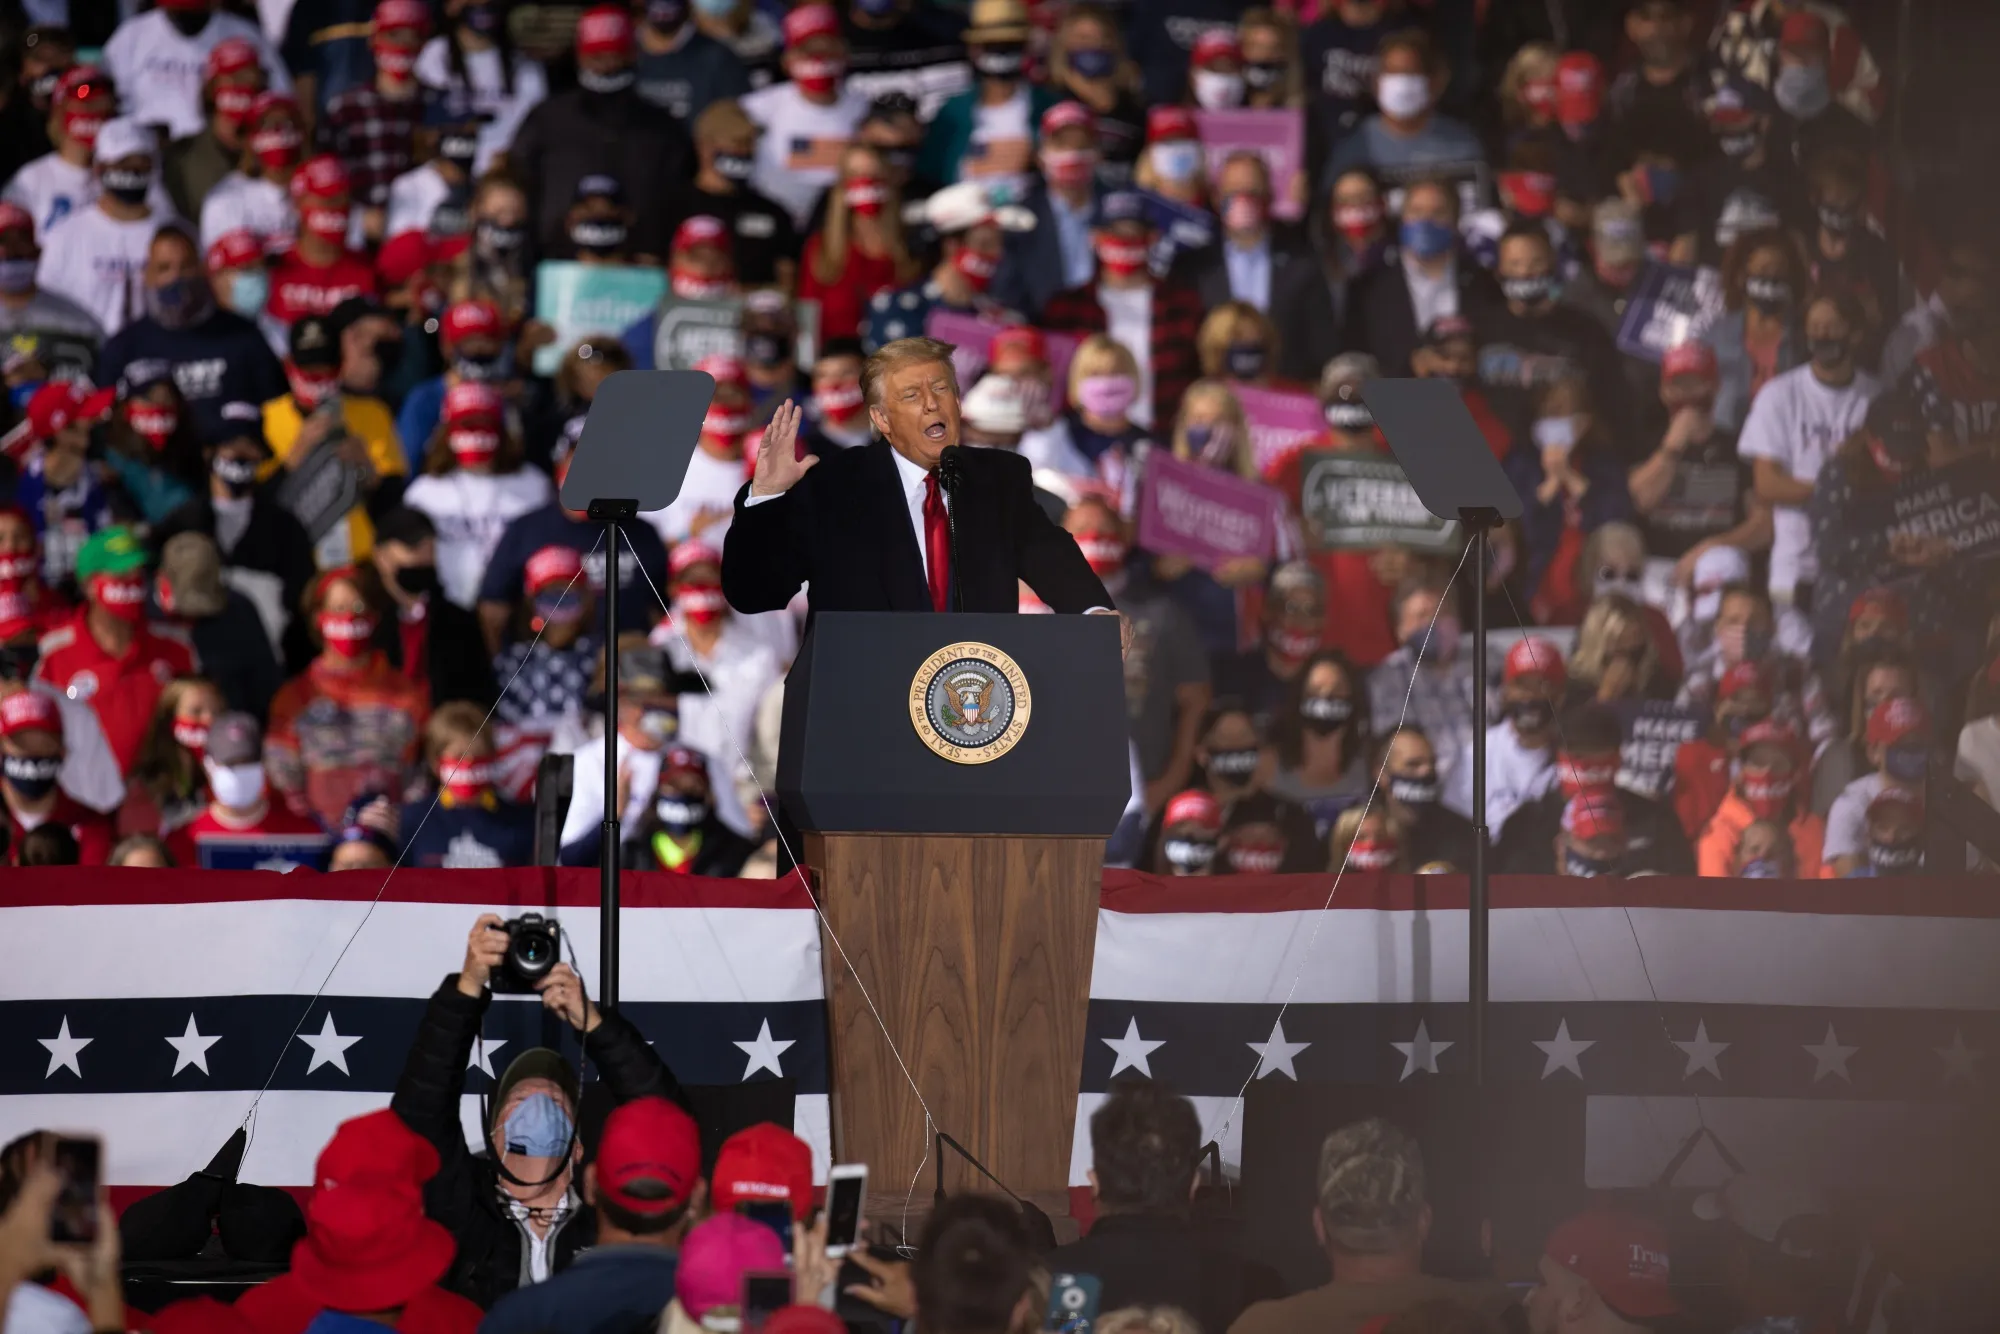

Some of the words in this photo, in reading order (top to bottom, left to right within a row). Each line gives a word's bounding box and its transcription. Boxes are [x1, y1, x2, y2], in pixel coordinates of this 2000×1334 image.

[1885, 491, 2000, 556] MERICA
[968, 647, 981, 656] OF
[982, 649, 998, 662] THE
[913, 646, 966, 701] PRESIDENT
[1000, 659, 1027, 709] UNITED
[915, 705, 926, 723] THE
[920, 723, 931, 735] OF
[982, 719, 1023, 758] STATES
[930, 733, 962, 758] SEAL
[1628, 1244, 1669, 1266] Tru
